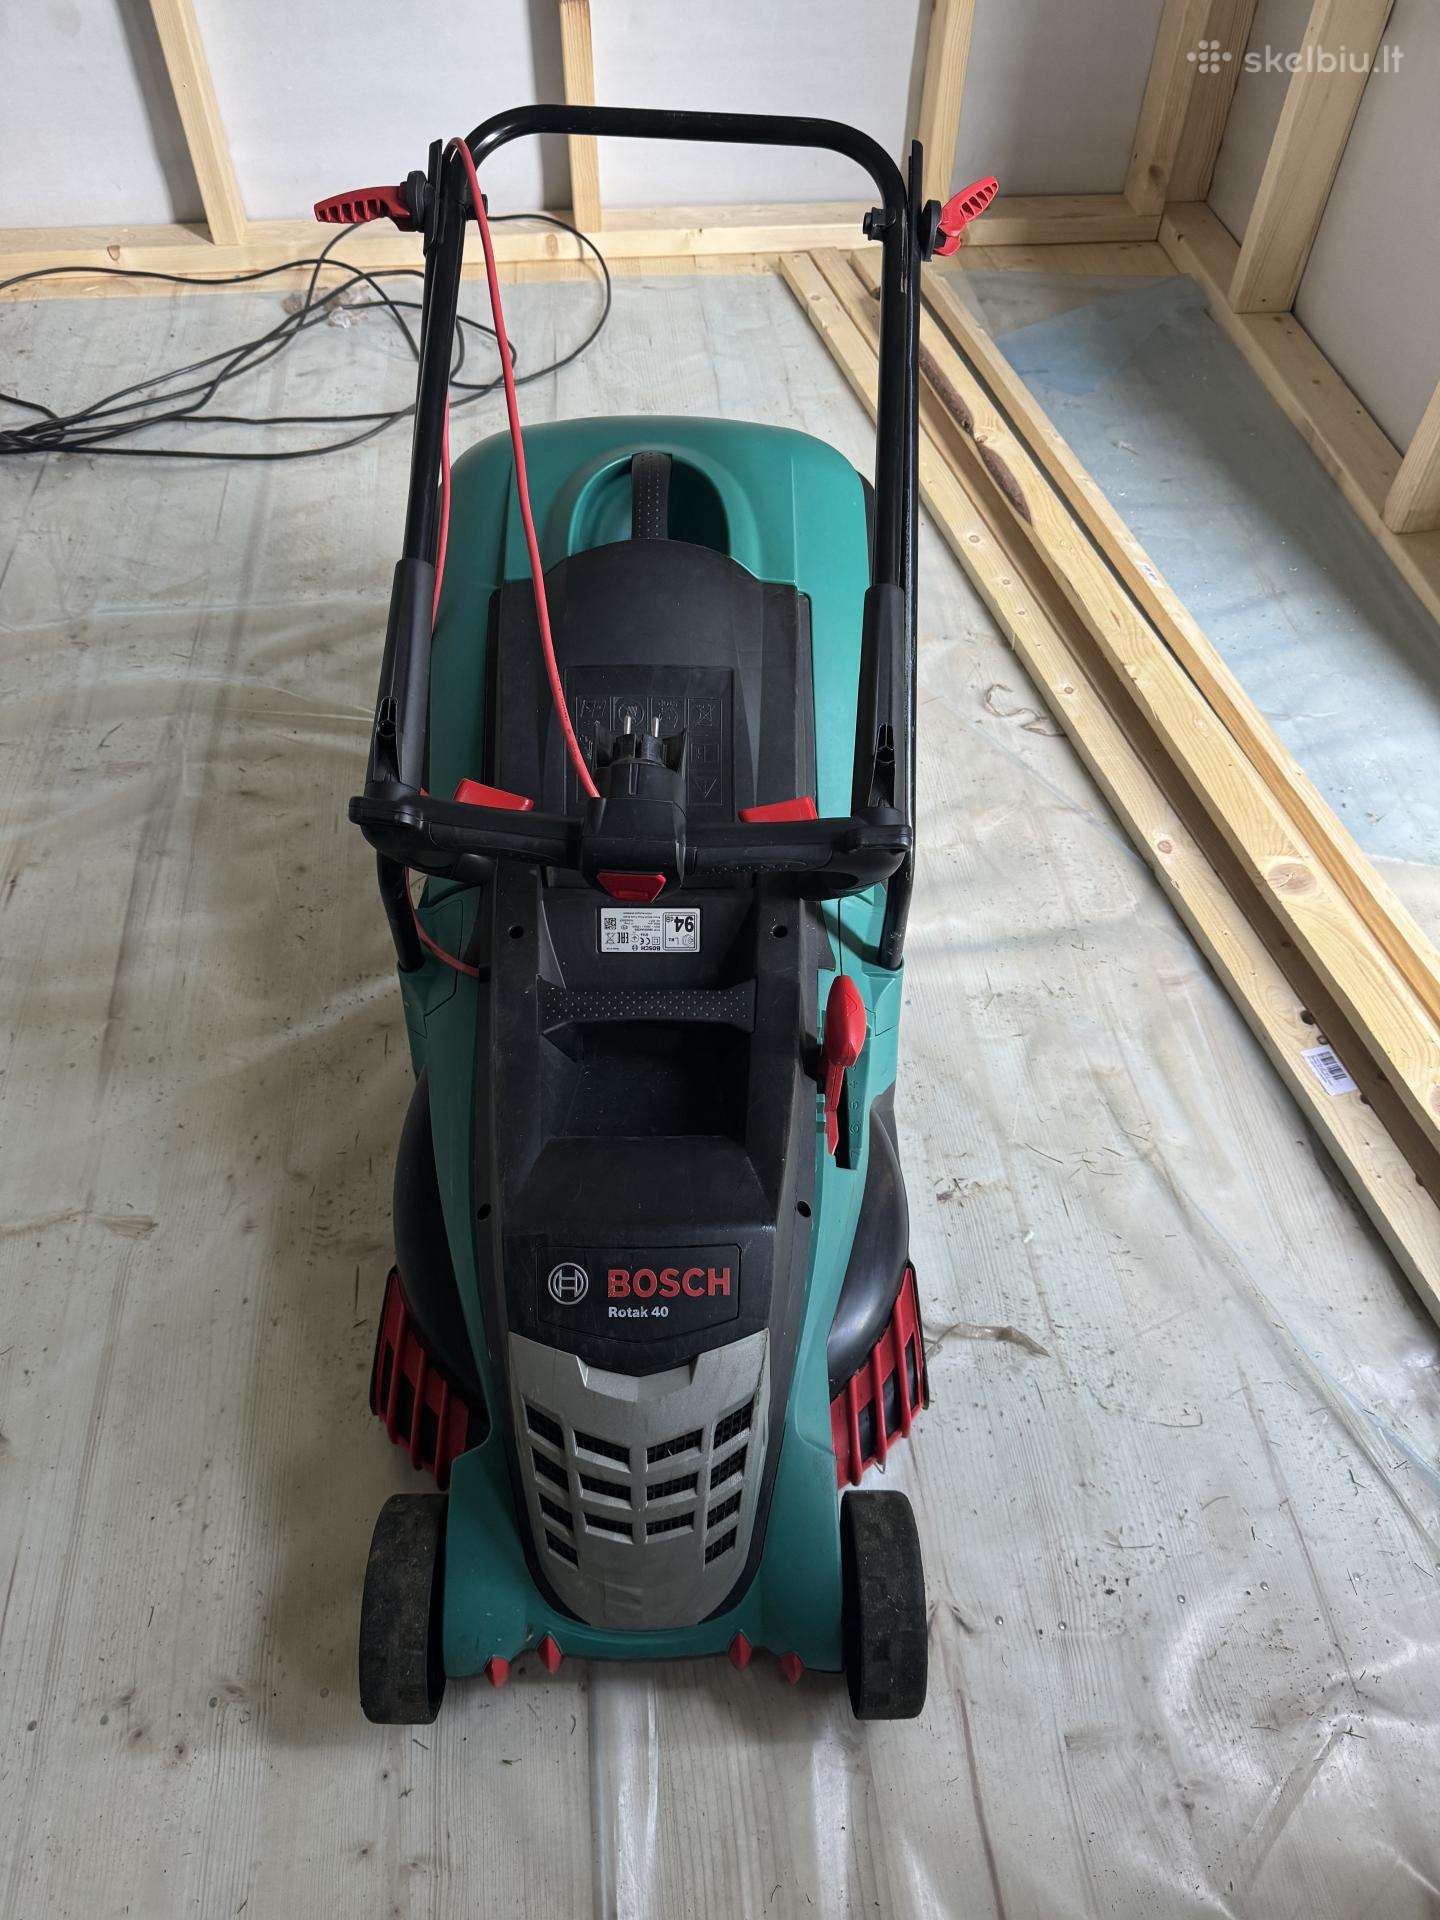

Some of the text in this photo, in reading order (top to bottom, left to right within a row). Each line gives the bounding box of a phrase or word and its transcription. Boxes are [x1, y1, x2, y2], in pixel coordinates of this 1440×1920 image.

[674, 916, 694, 933] 94
[608, 1267, 731, 1298] BOSCH
[608, 1306, 669, 1318] Rotak 40
